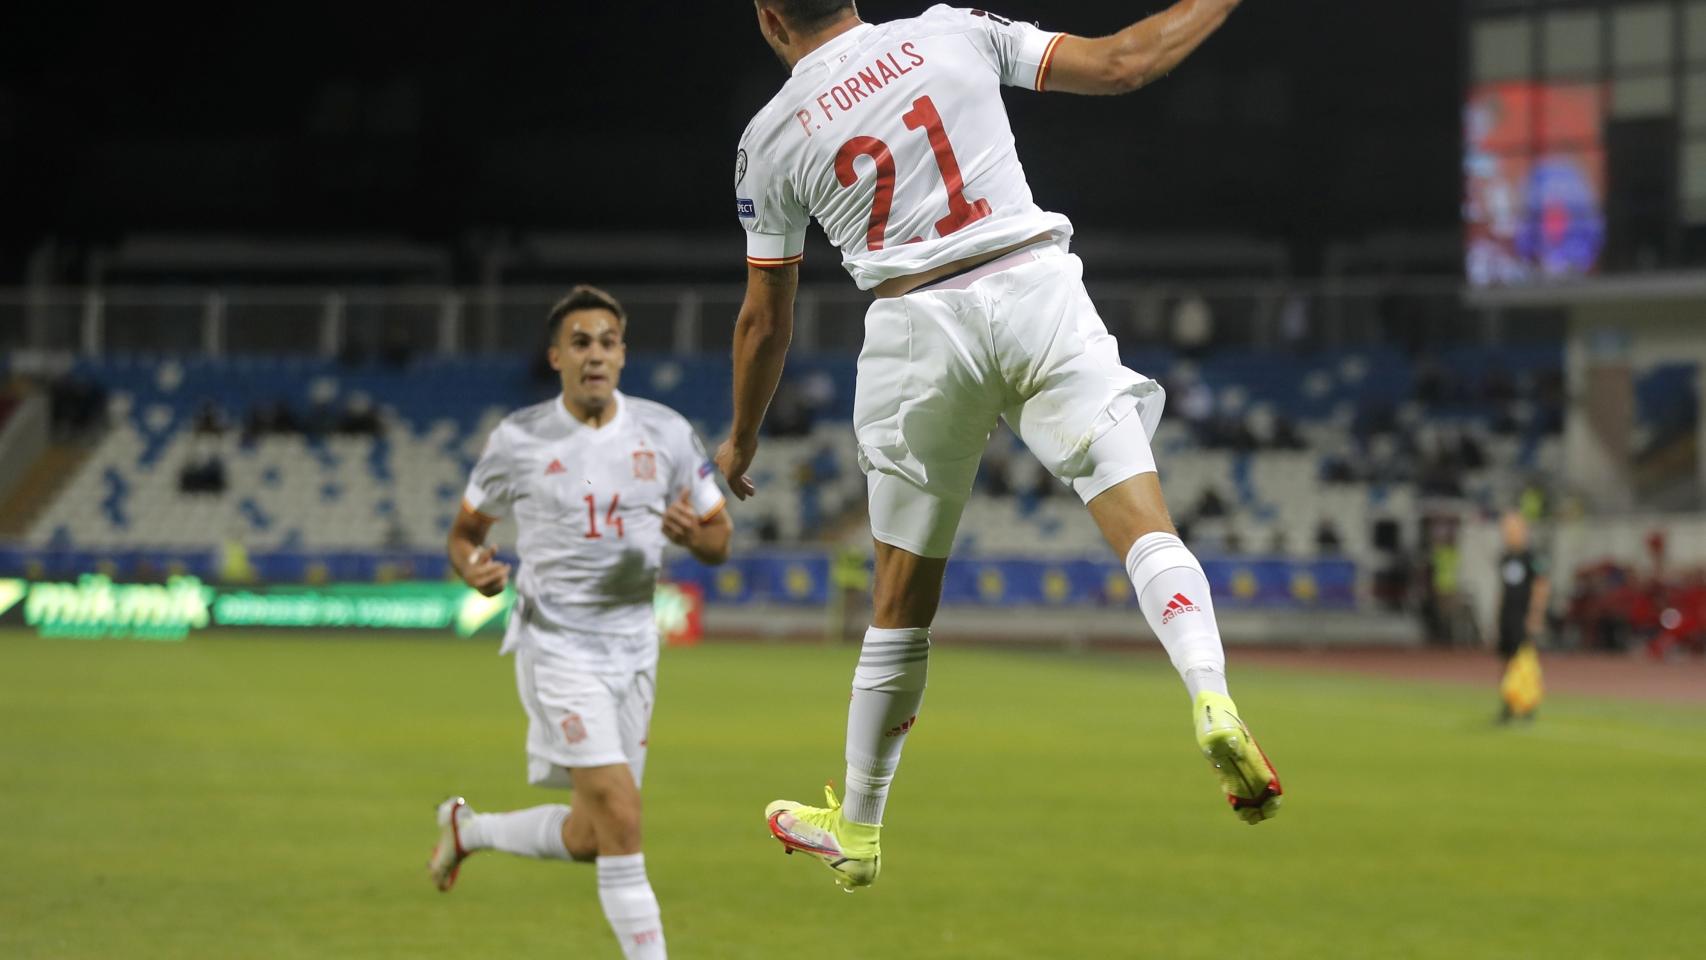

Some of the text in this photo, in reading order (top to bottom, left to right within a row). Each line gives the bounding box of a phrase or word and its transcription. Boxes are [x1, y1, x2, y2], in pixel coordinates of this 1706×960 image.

[796, 42, 925, 137] P. FORNALS
[834, 95, 992, 251] 21
[583, 493, 625, 540] 14
[1162, 605, 1201, 625] adidas
